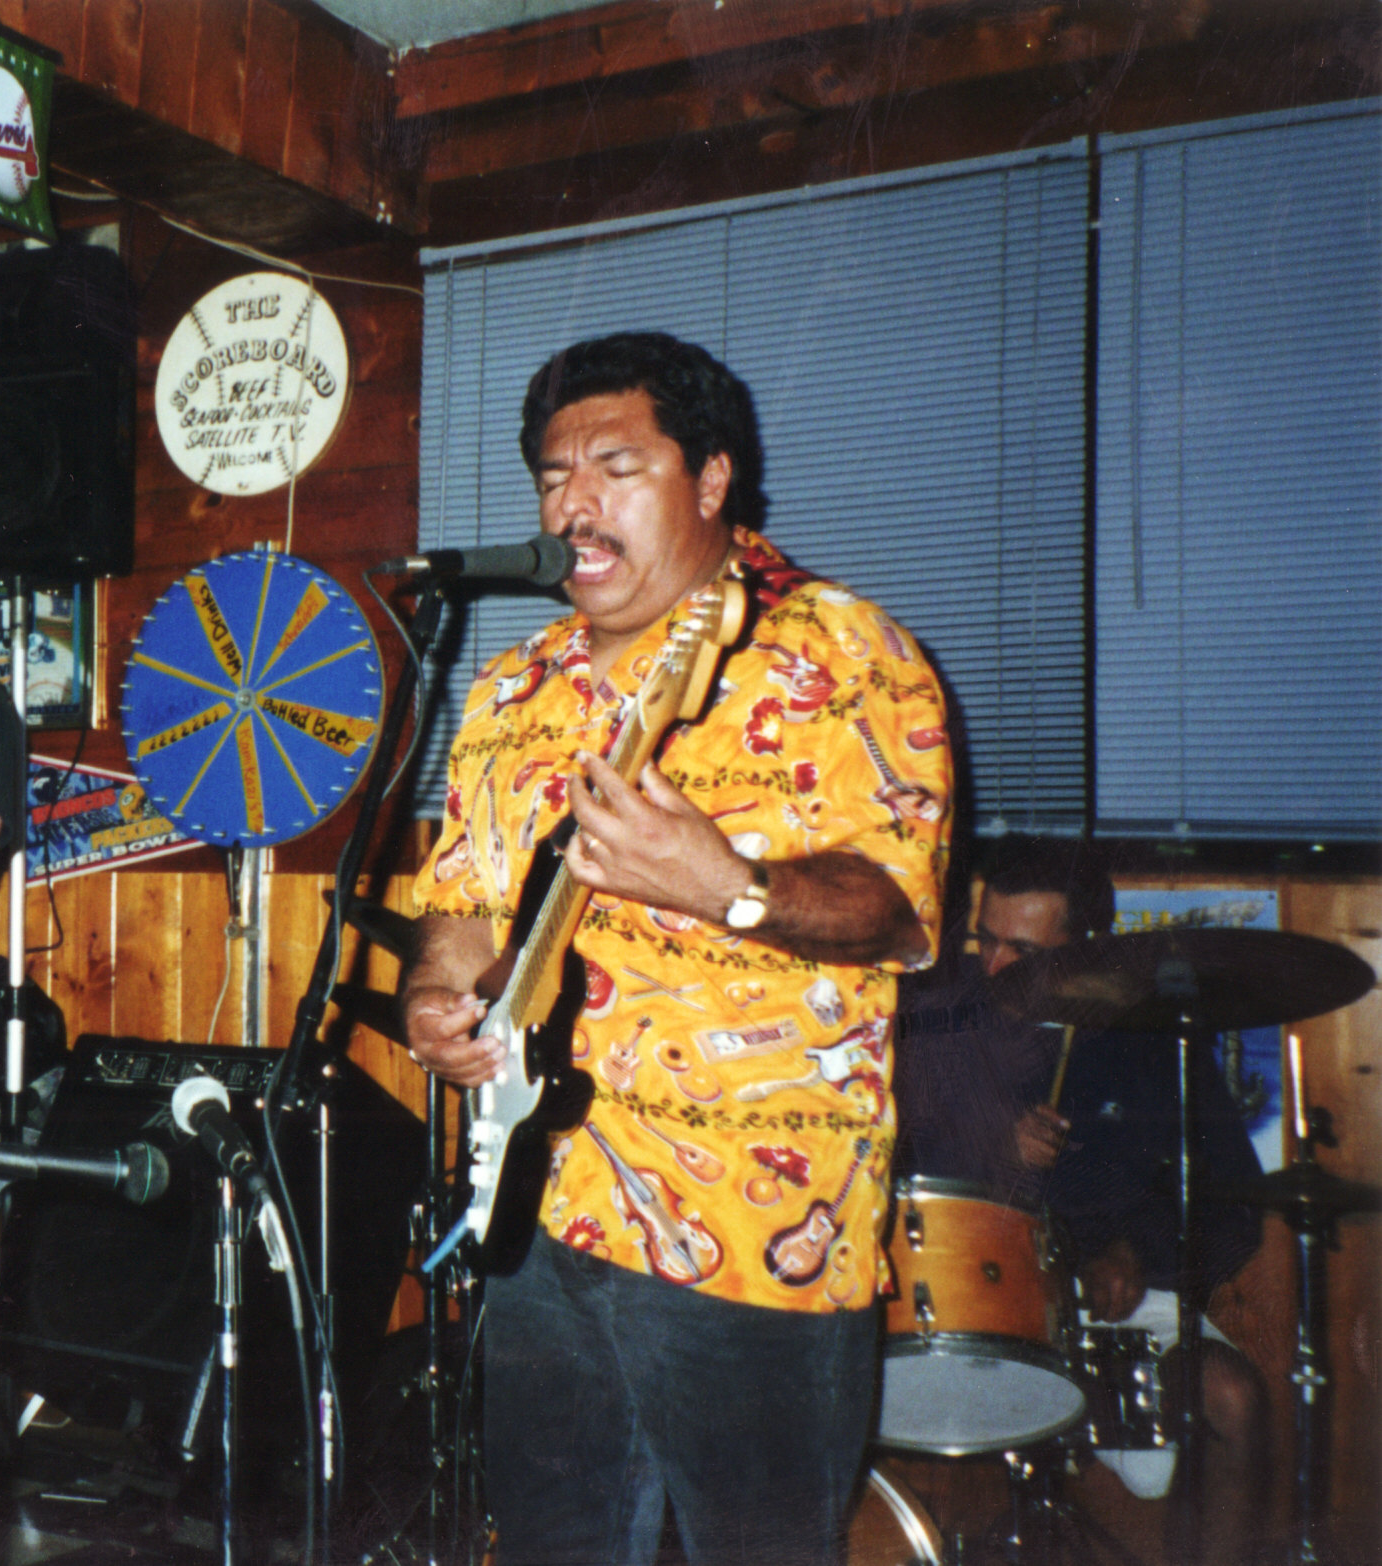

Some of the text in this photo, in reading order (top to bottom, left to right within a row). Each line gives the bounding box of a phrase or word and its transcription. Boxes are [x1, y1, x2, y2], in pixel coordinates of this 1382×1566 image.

[224, 294, 281, 324] THE
[170, 338, 337, 413] SCOREBOARD
[230, 378, 273, 404] BEEF
[185, 425, 259, 451] SATELLITE
[198, 584, 229, 643] Drinks
[262, 699, 308, 731] Bottled
[311, 715, 355, 748] Beer
[34, 832, 183, 876] SUPER BOWL
